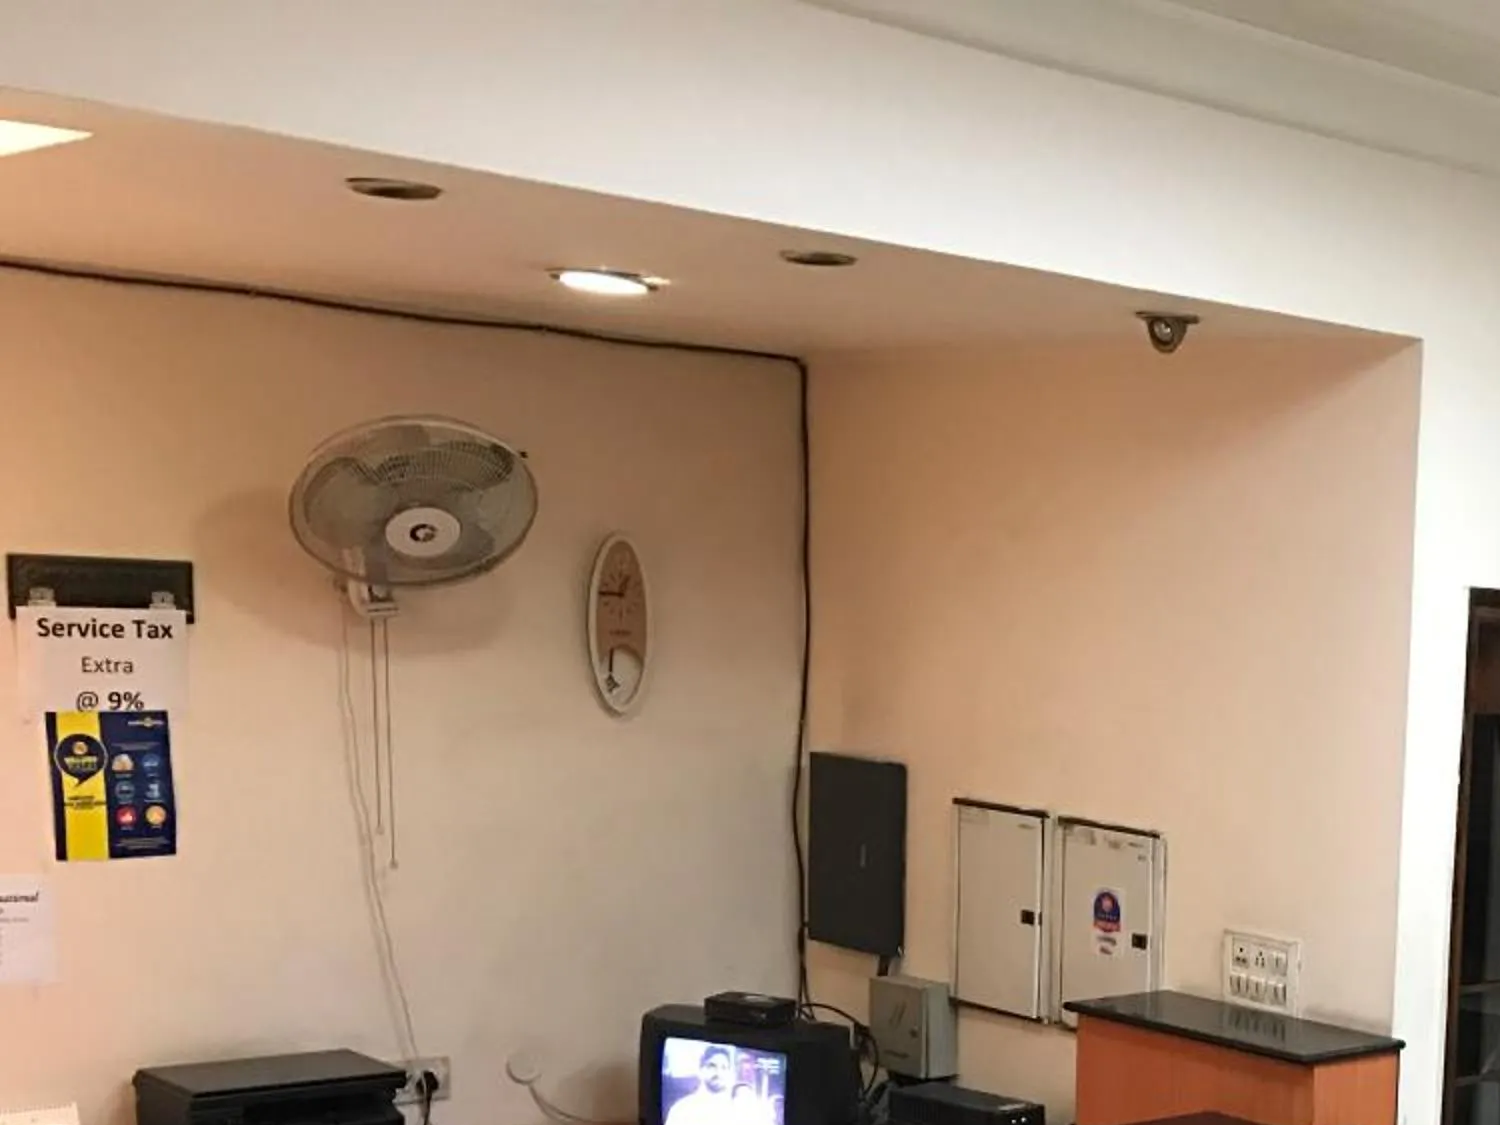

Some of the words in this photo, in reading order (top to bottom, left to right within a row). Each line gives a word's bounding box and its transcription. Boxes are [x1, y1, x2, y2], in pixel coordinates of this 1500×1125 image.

[37, 617, 125, 638] Service
[132, 619, 173, 639] Tax
[81, 656, 134, 674] Extra
[76, 691, 99, 713] @
[107, 691, 144, 711] 9%
